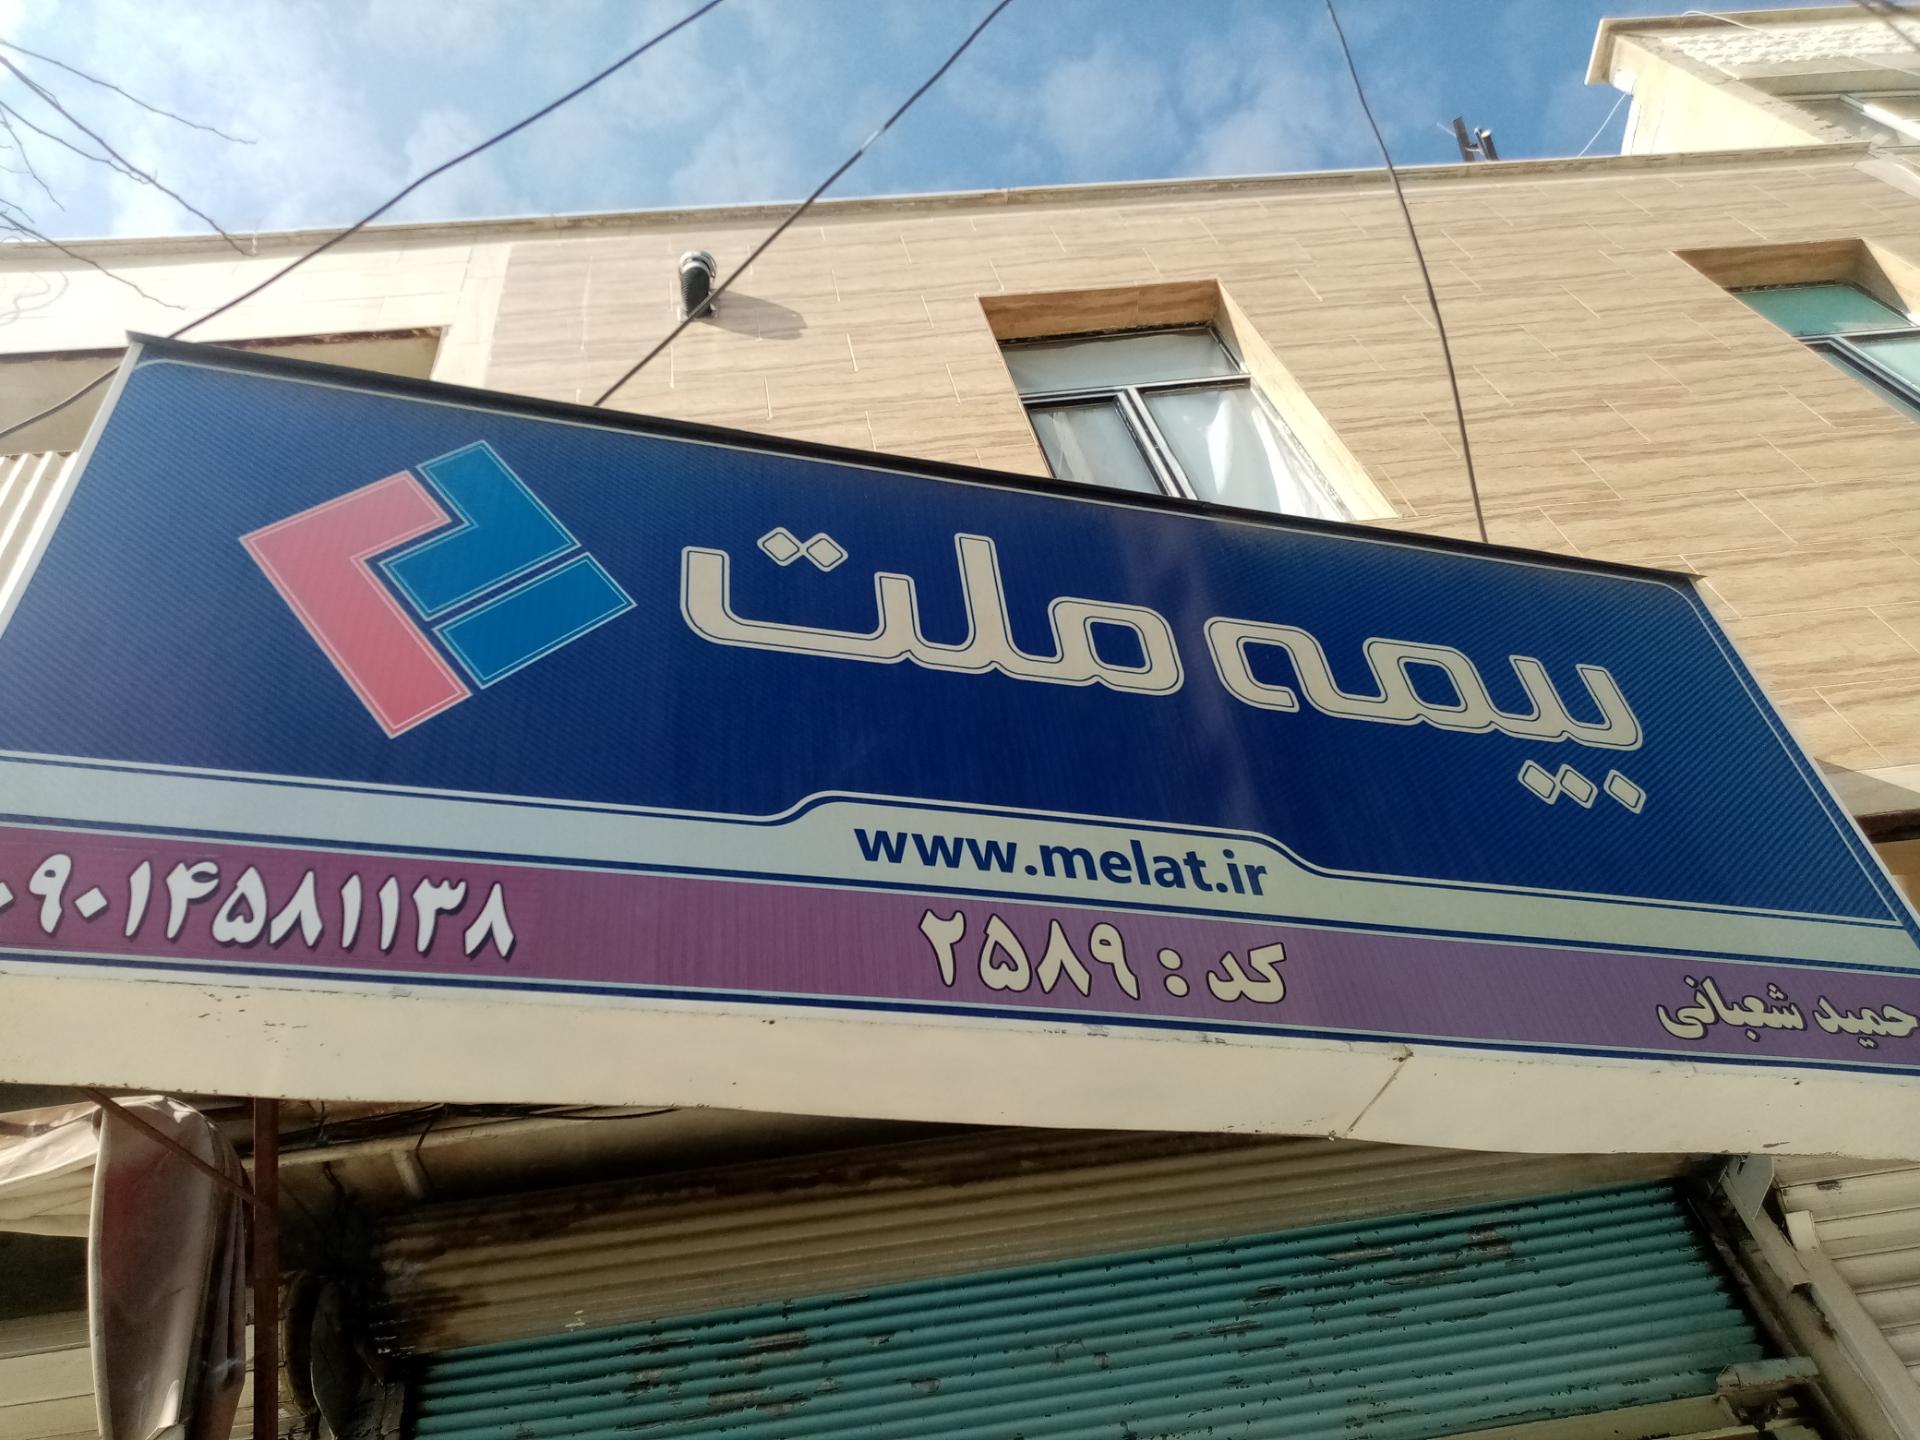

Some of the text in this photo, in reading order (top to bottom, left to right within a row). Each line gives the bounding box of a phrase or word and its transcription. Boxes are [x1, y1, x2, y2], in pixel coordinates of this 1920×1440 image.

[680, 526, 1646, 814] بیمه ملت
[854, 827, 1267, 896] www.melat.ir
[919, 908, 1140, 1000] ۲۵۸۹
[1656, 975, 1920, 1049] حمید شعبانی
